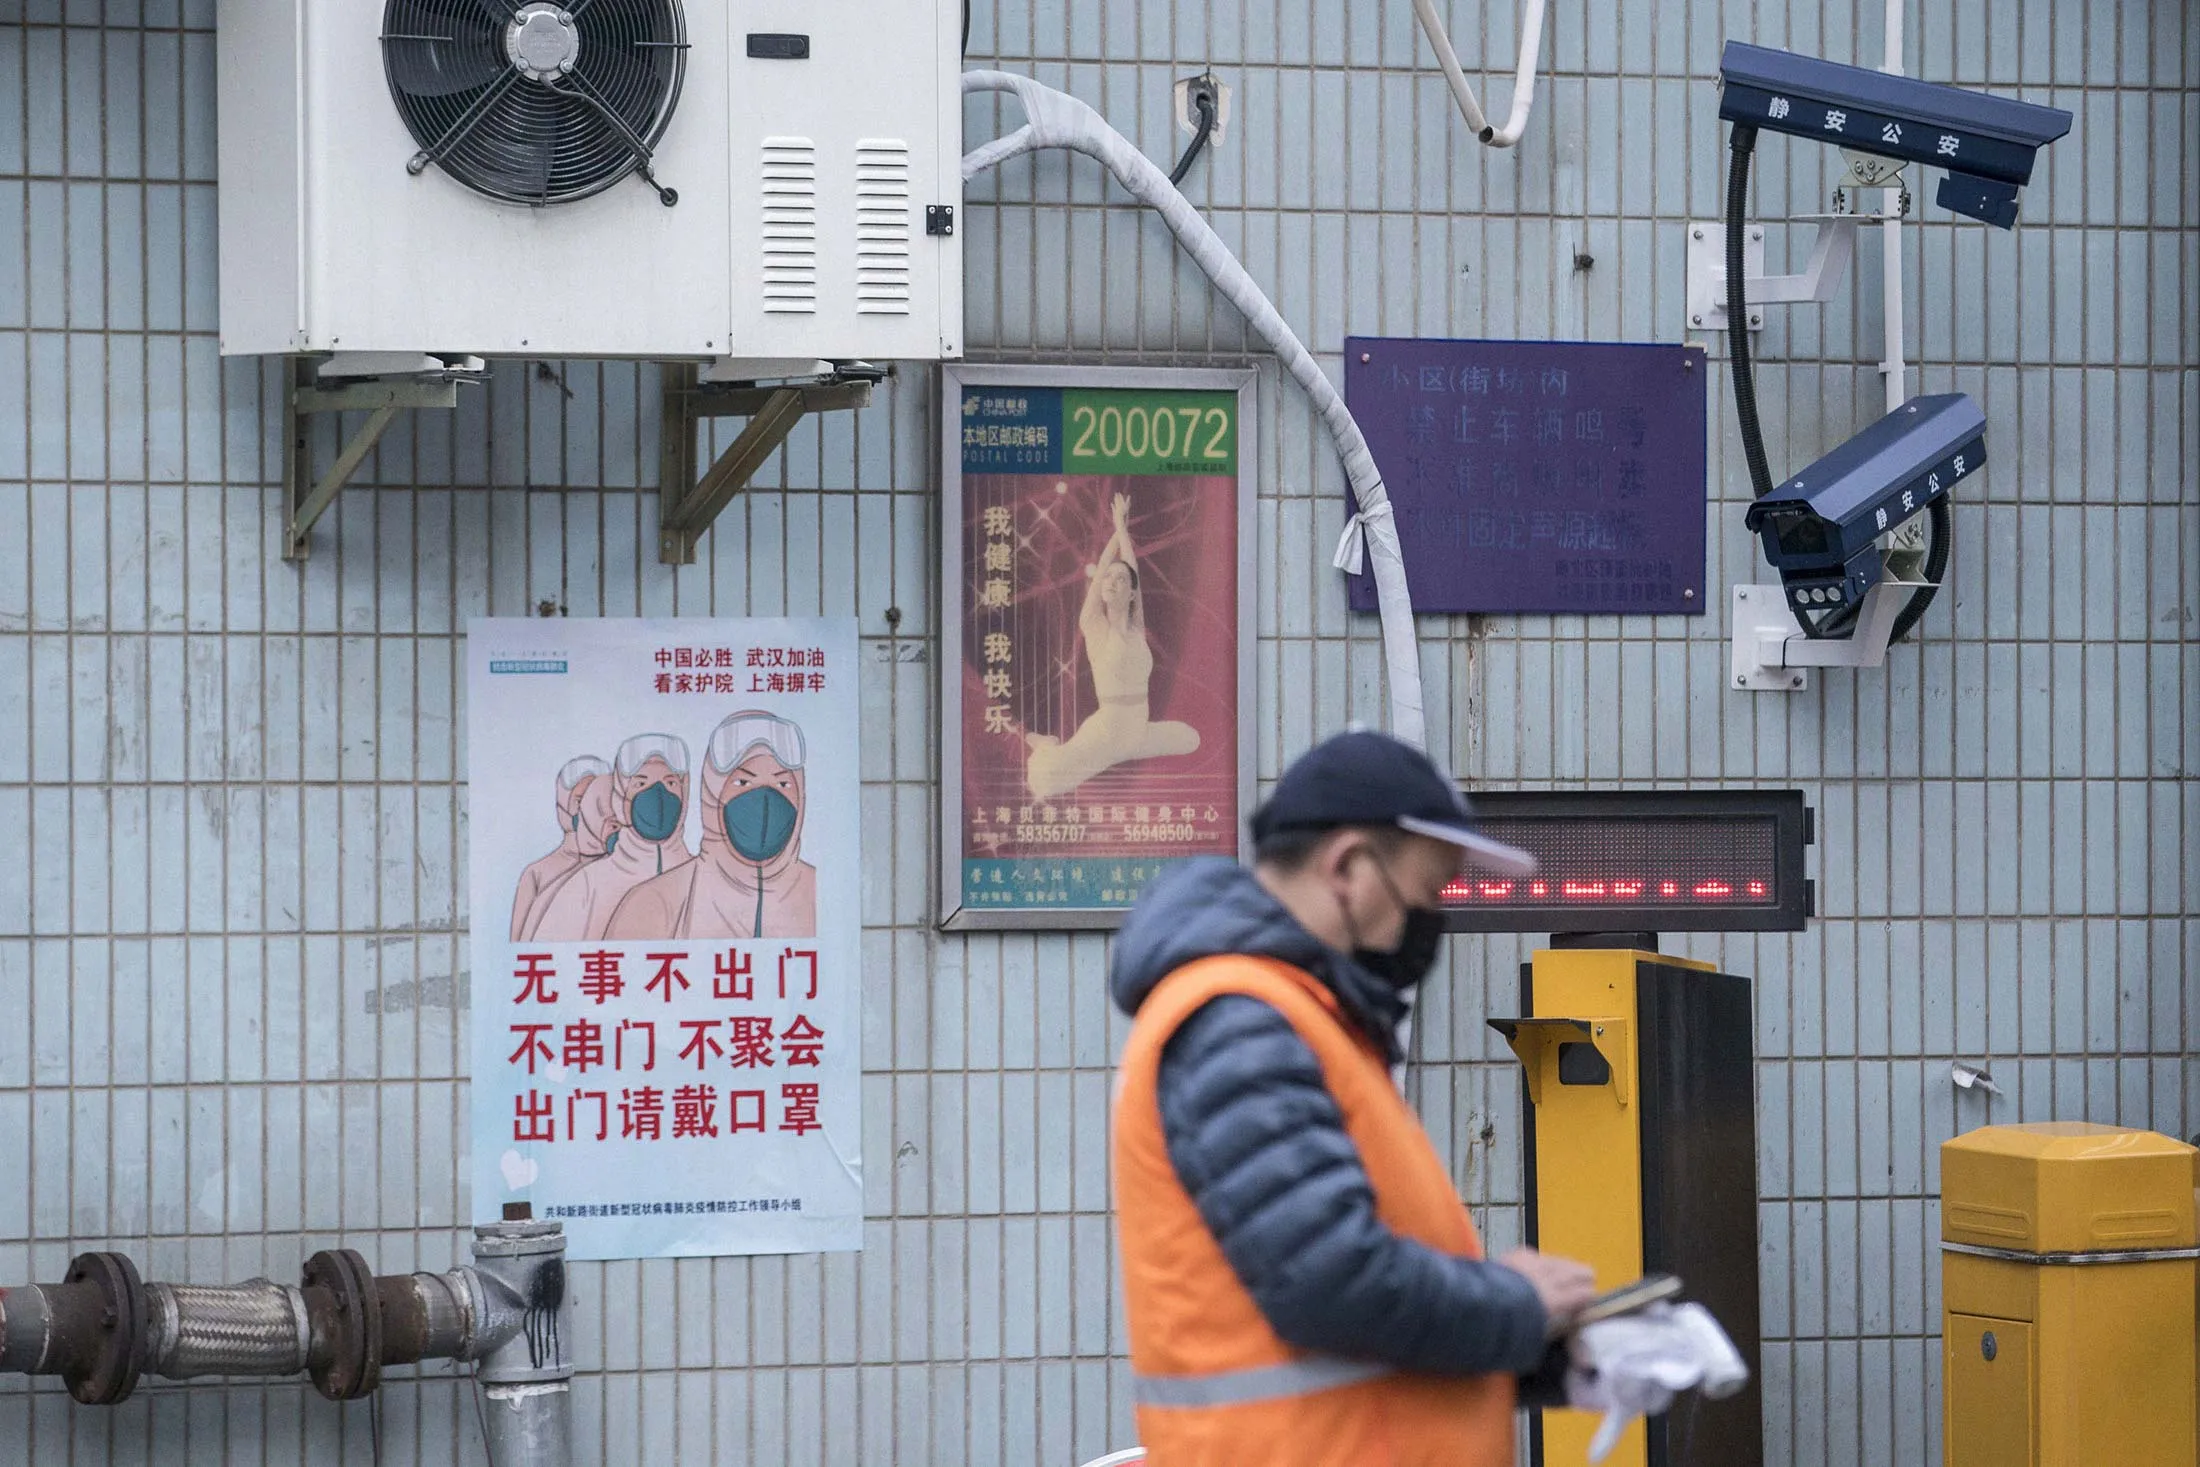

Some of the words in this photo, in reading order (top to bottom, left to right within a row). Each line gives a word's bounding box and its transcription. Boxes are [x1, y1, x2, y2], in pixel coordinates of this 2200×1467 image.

[1767, 97, 1960, 158] 静安公安
[963, 425, 1049, 448] 本地区邮政编码
[963, 450, 1008, 463] POSTAL
[1016, 450, 1048, 463] CODE
[1072, 406, 1229, 458] 200072
[1875, 455, 1965, 531] 静安公安
[983, 506, 1012, 608] 我健康
[654, 647, 733, 668] 中国必胜
[746, 647, 825, 668] 武汉加油
[654, 673, 734, 694] 看家护院
[746, 672, 826, 693] 上海摒牢
[983, 632, 1014, 734] 我快乐
[1016, 824, 1086, 843] 58356707
[1123, 824, 1193, 842] 56948500
[512, 948, 818, 1005] 无事不出门
[508, 1018, 656, 1075] 不串门
[678, 1014, 825, 1070] 不聚会
[512, 1083, 823, 1143] 出门请戴口罩
